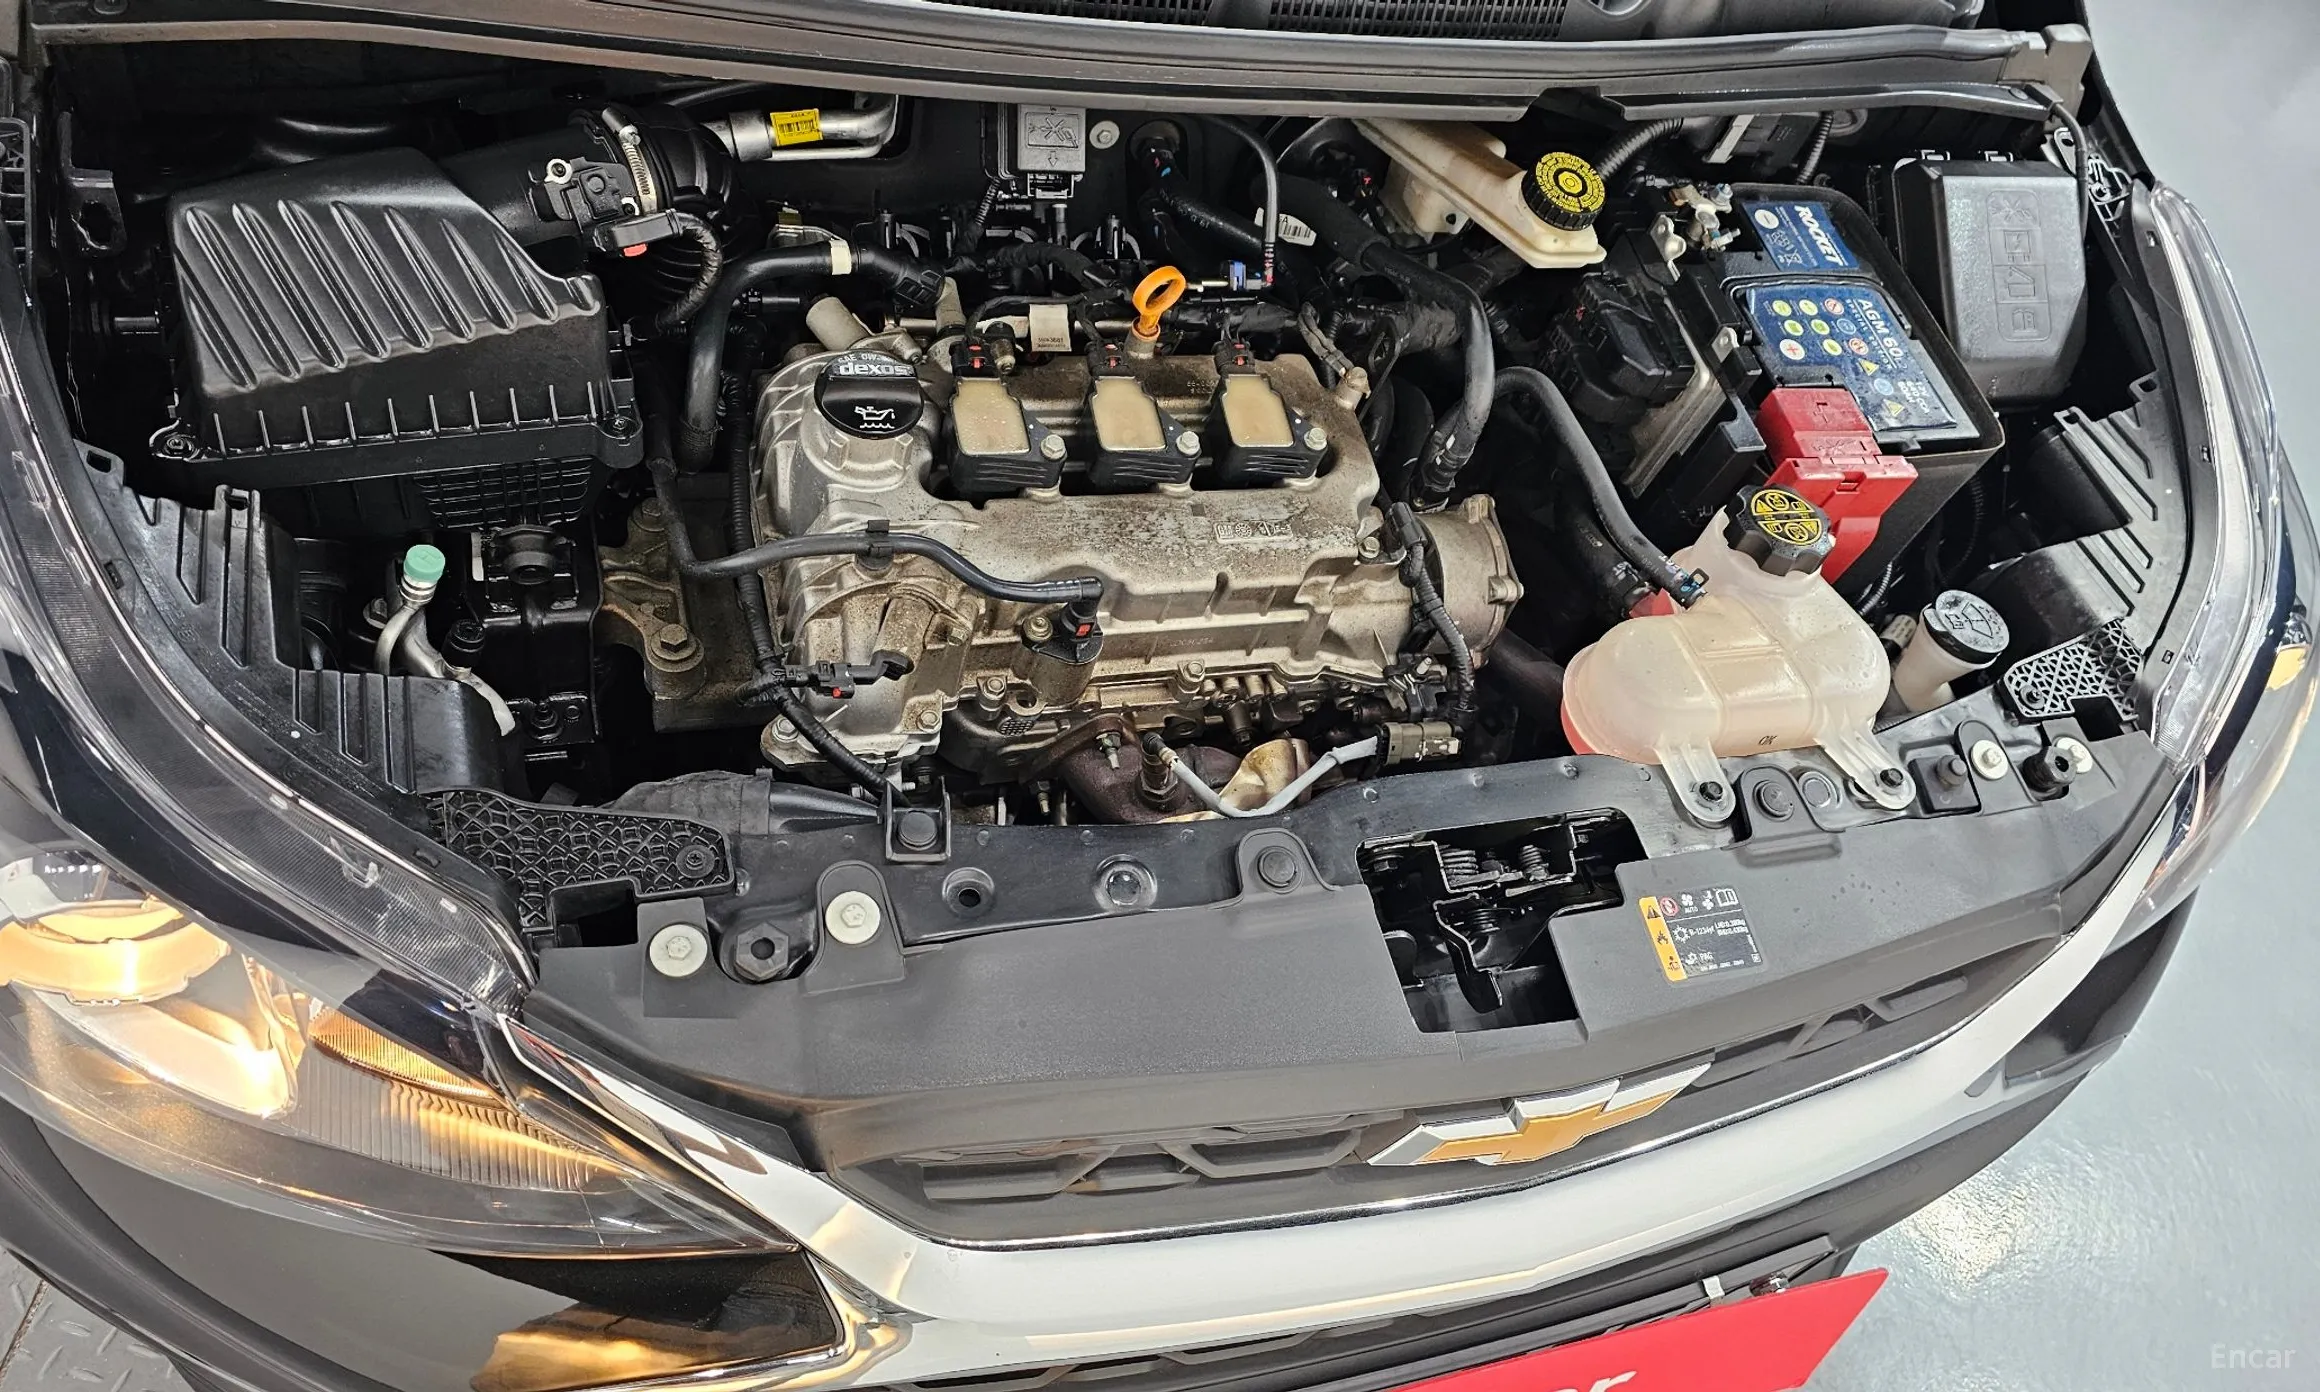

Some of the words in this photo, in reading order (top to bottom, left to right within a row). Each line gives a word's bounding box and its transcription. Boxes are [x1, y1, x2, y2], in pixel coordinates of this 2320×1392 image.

[1794, 205, 1844, 266] ROCKET
[1846, 299, 1869, 331] SPECIAL
[1869, 336, 1893, 369] EDITION
[1858, 299, 1890, 334] AGM
[839, 362, 907, 376] dexos
